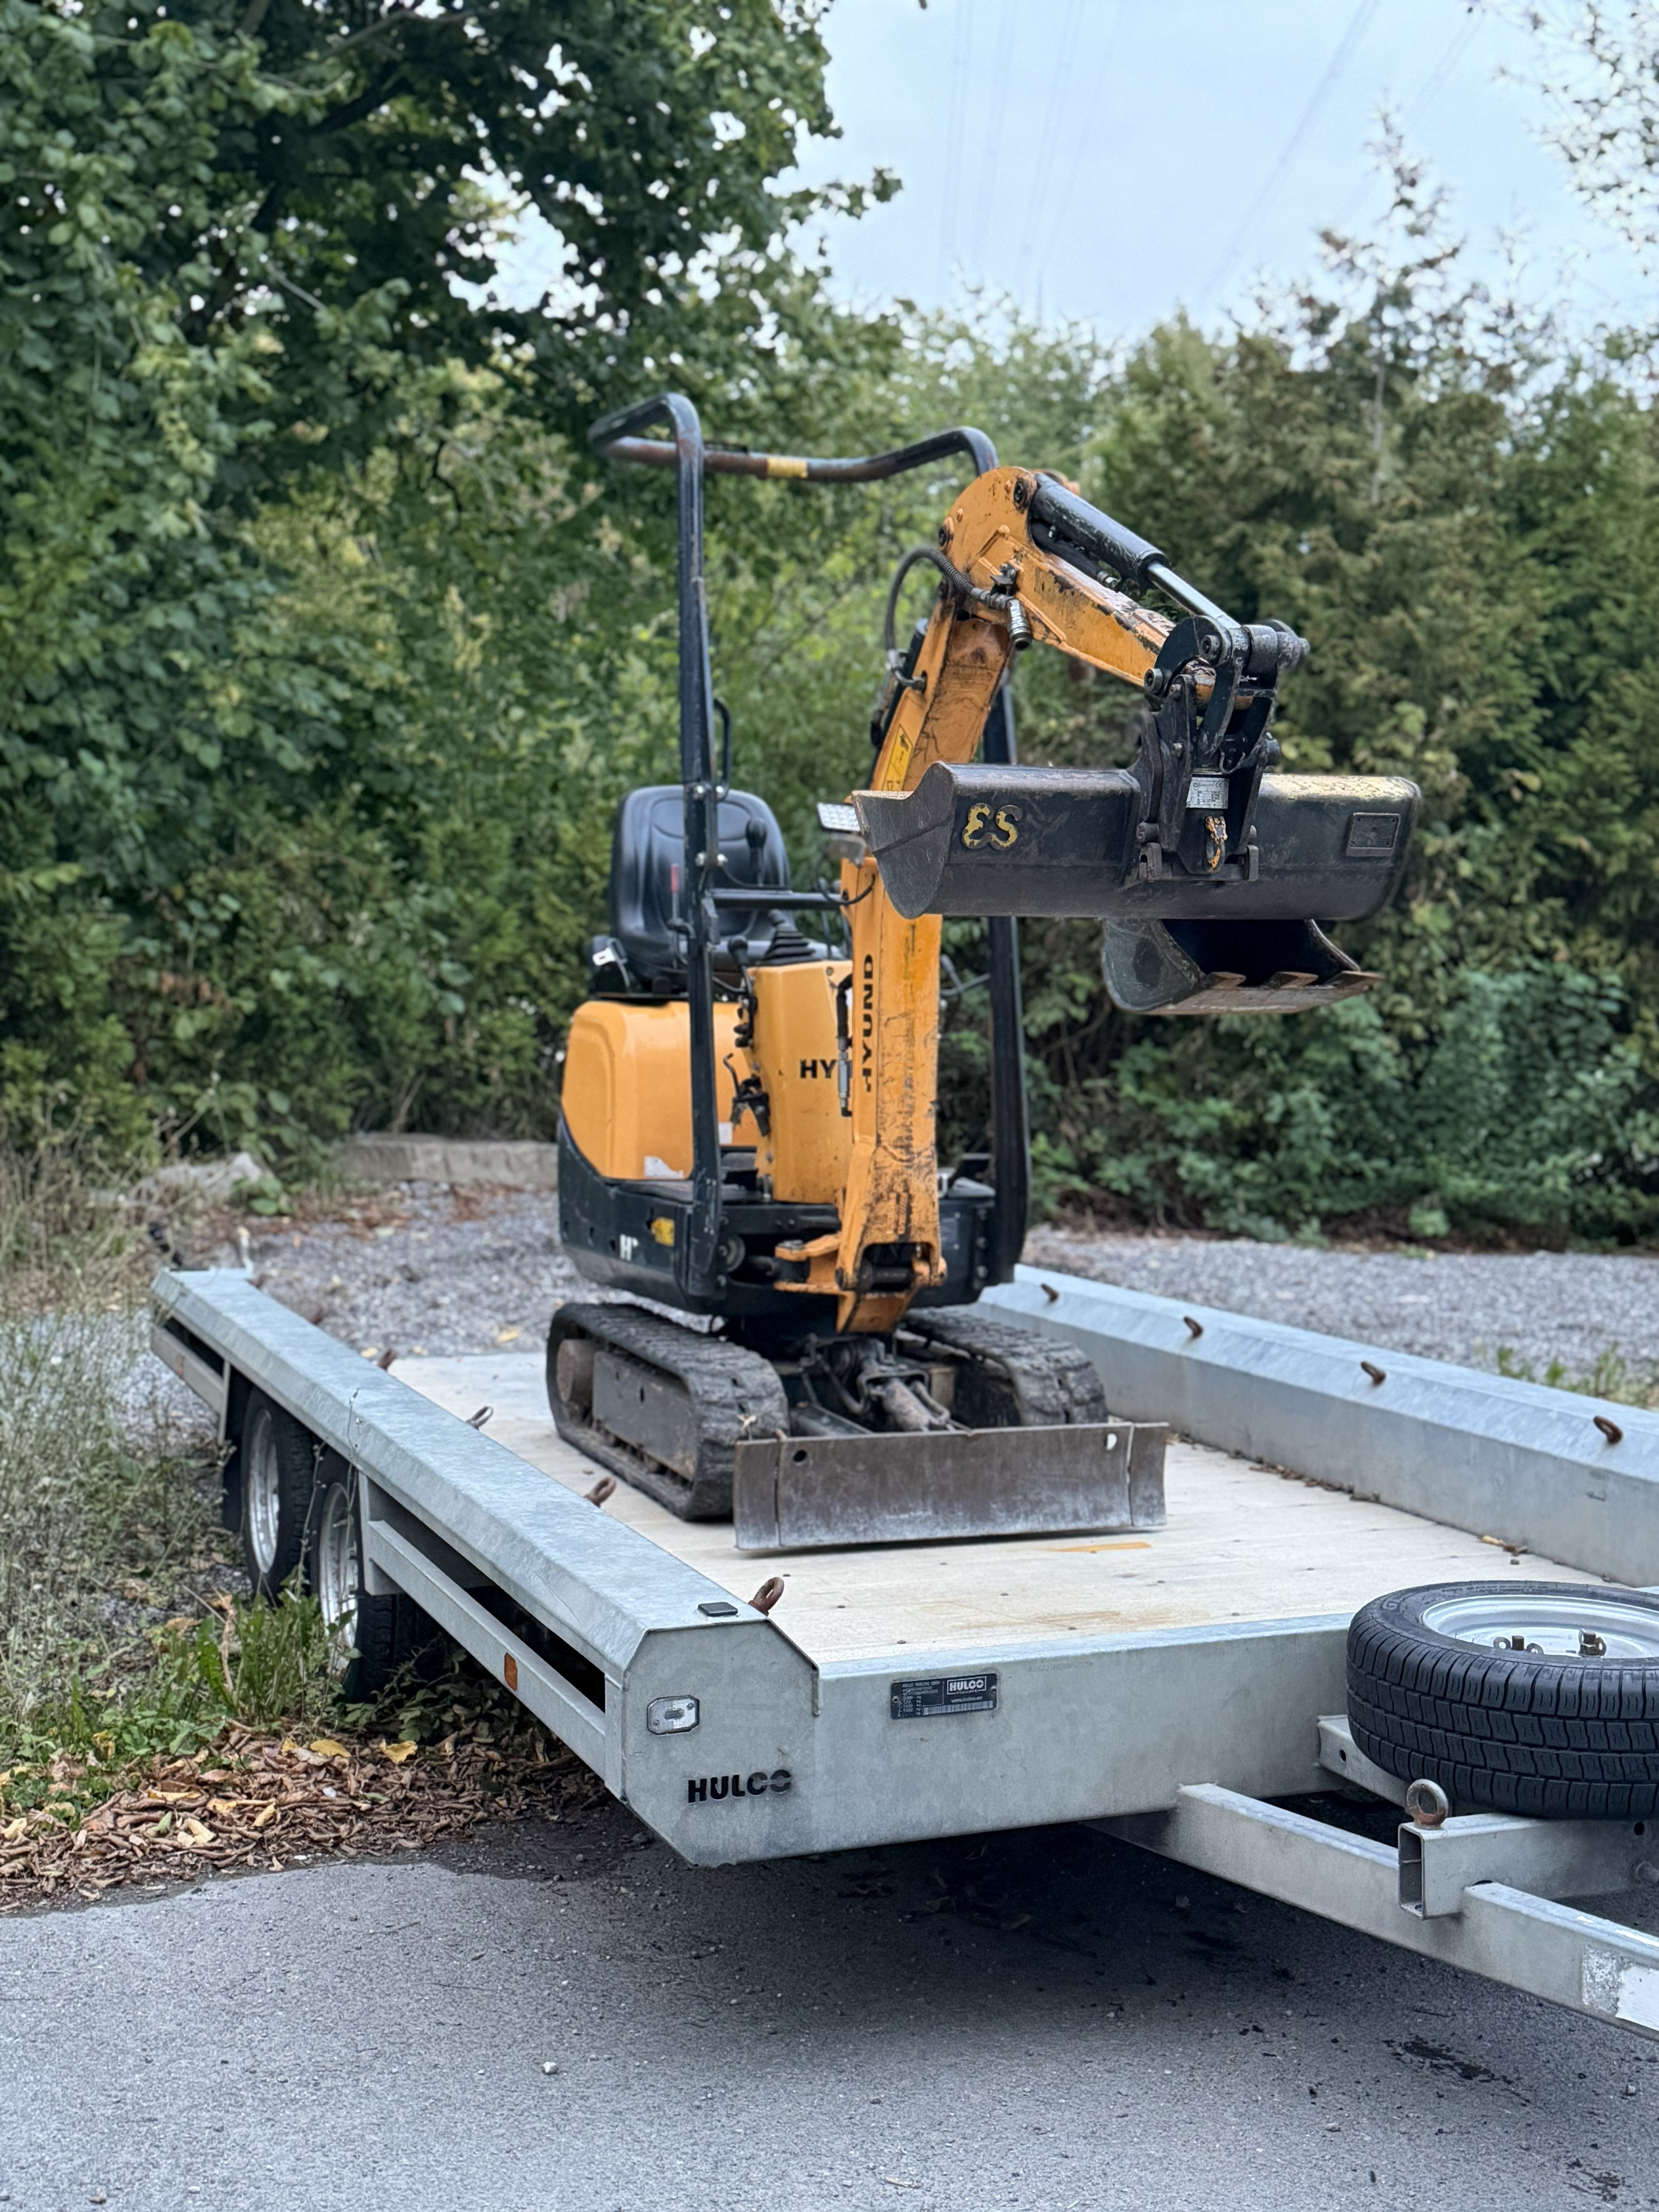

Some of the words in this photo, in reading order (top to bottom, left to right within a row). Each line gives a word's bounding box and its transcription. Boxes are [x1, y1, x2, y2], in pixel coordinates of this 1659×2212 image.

[800, 1059, 852, 1079] HY
[949, 1679, 984, 1692] HULCO
[688, 1769, 792, 1803] HULCO
